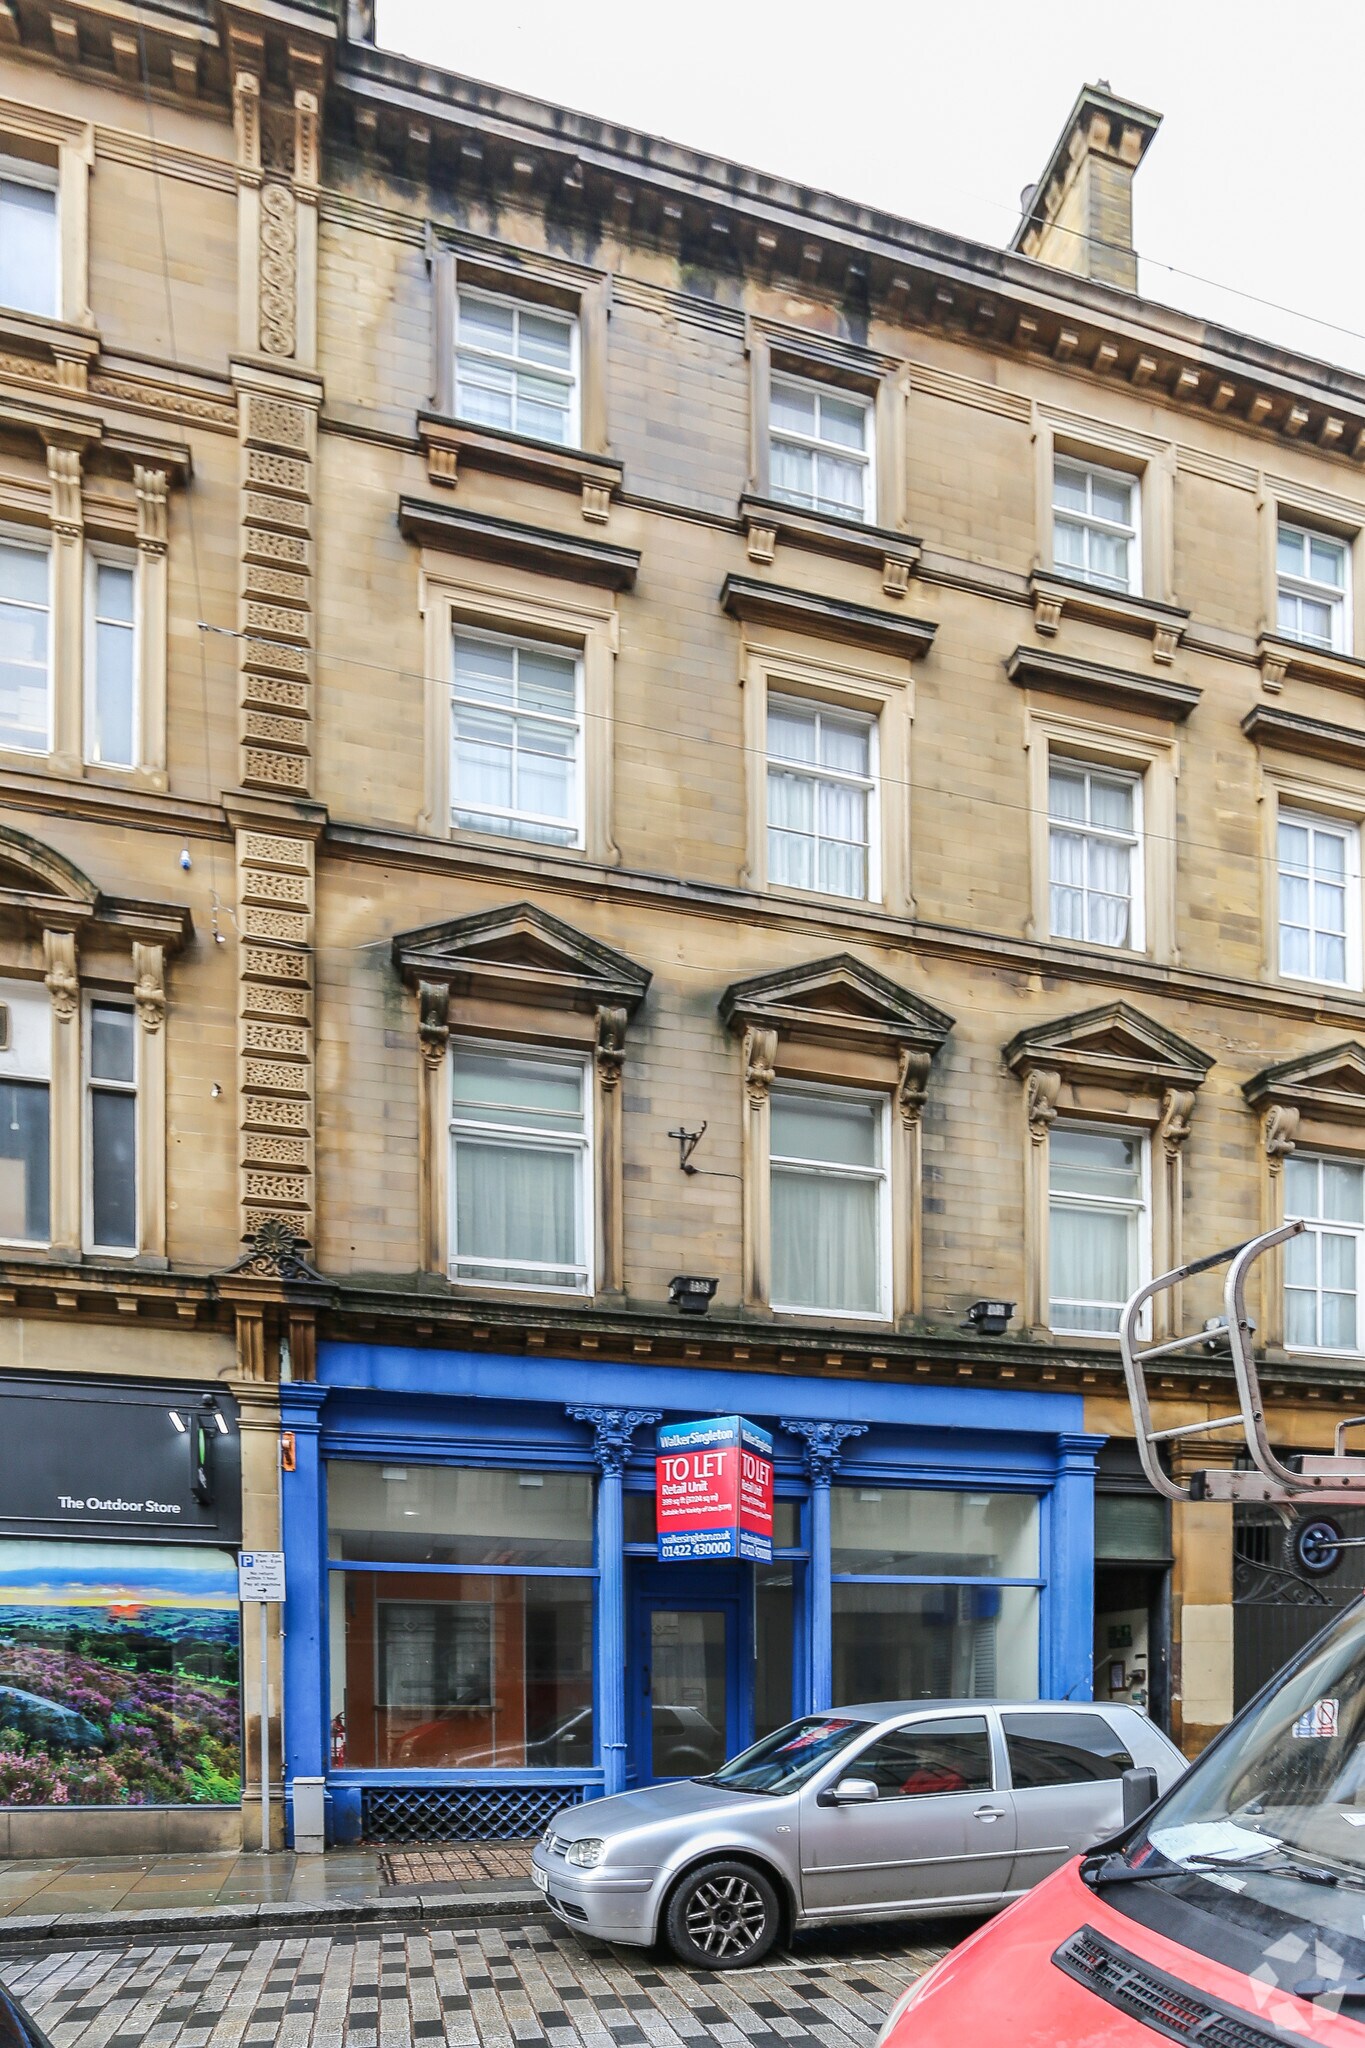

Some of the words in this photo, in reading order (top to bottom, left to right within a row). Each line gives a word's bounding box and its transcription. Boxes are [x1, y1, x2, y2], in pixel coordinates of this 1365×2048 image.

[661, 1457, 690, 1482] TO
[694, 1452, 728, 1478] LET
[741, 1453, 755, 1479] TO
[755, 1460, 771, 1486] LET
[661, 1482, 687, 1495] Retail
[688, 1480, 708, 1493] Unit
[57, 1496, 85, 1509] The
[86, 1497, 144, 1512] Outdoor
[145, 1500, 181, 1514] Store
[662, 1544, 692, 1557] 01422
[692, 1541, 732, 1555] 430000
[242, 1556, 253, 1567] P
